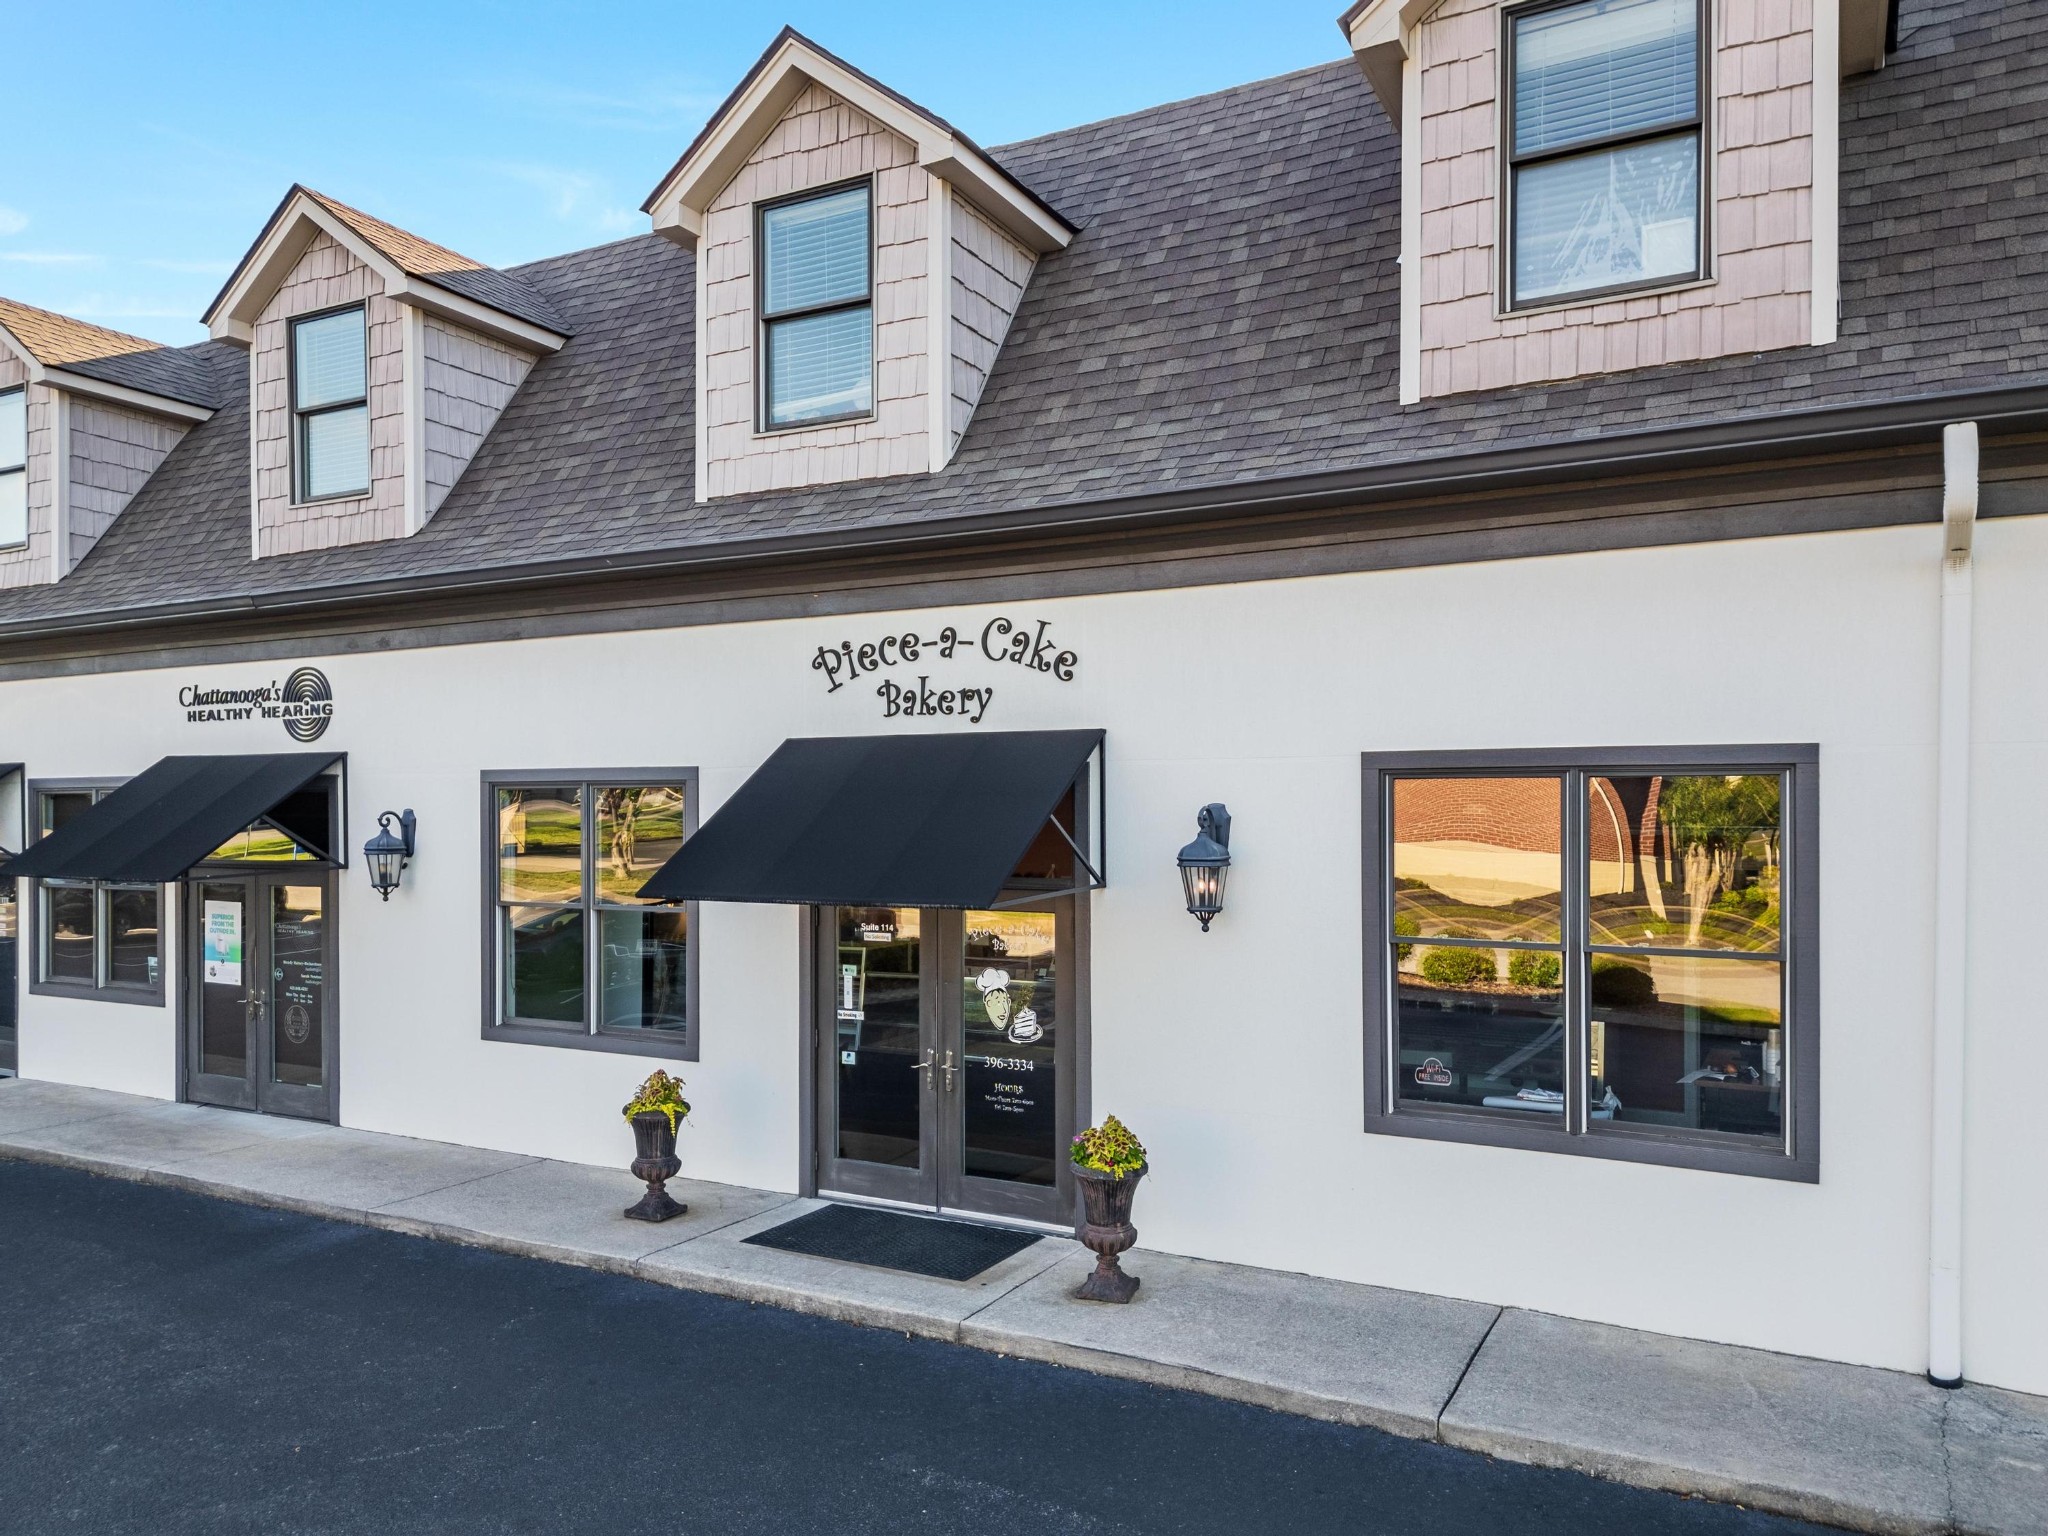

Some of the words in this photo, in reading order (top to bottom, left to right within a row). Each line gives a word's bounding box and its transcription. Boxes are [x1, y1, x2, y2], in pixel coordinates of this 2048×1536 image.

[178, 680, 282, 708] Chattanooga's
[876, 675, 993, 723] Bakery
[187, 707, 254, 722] HEALTHY
[861, 922, 880, 931] Suite
[881, 923, 894, 931] 114
[984, 1056, 1034, 1071] 396-3334
